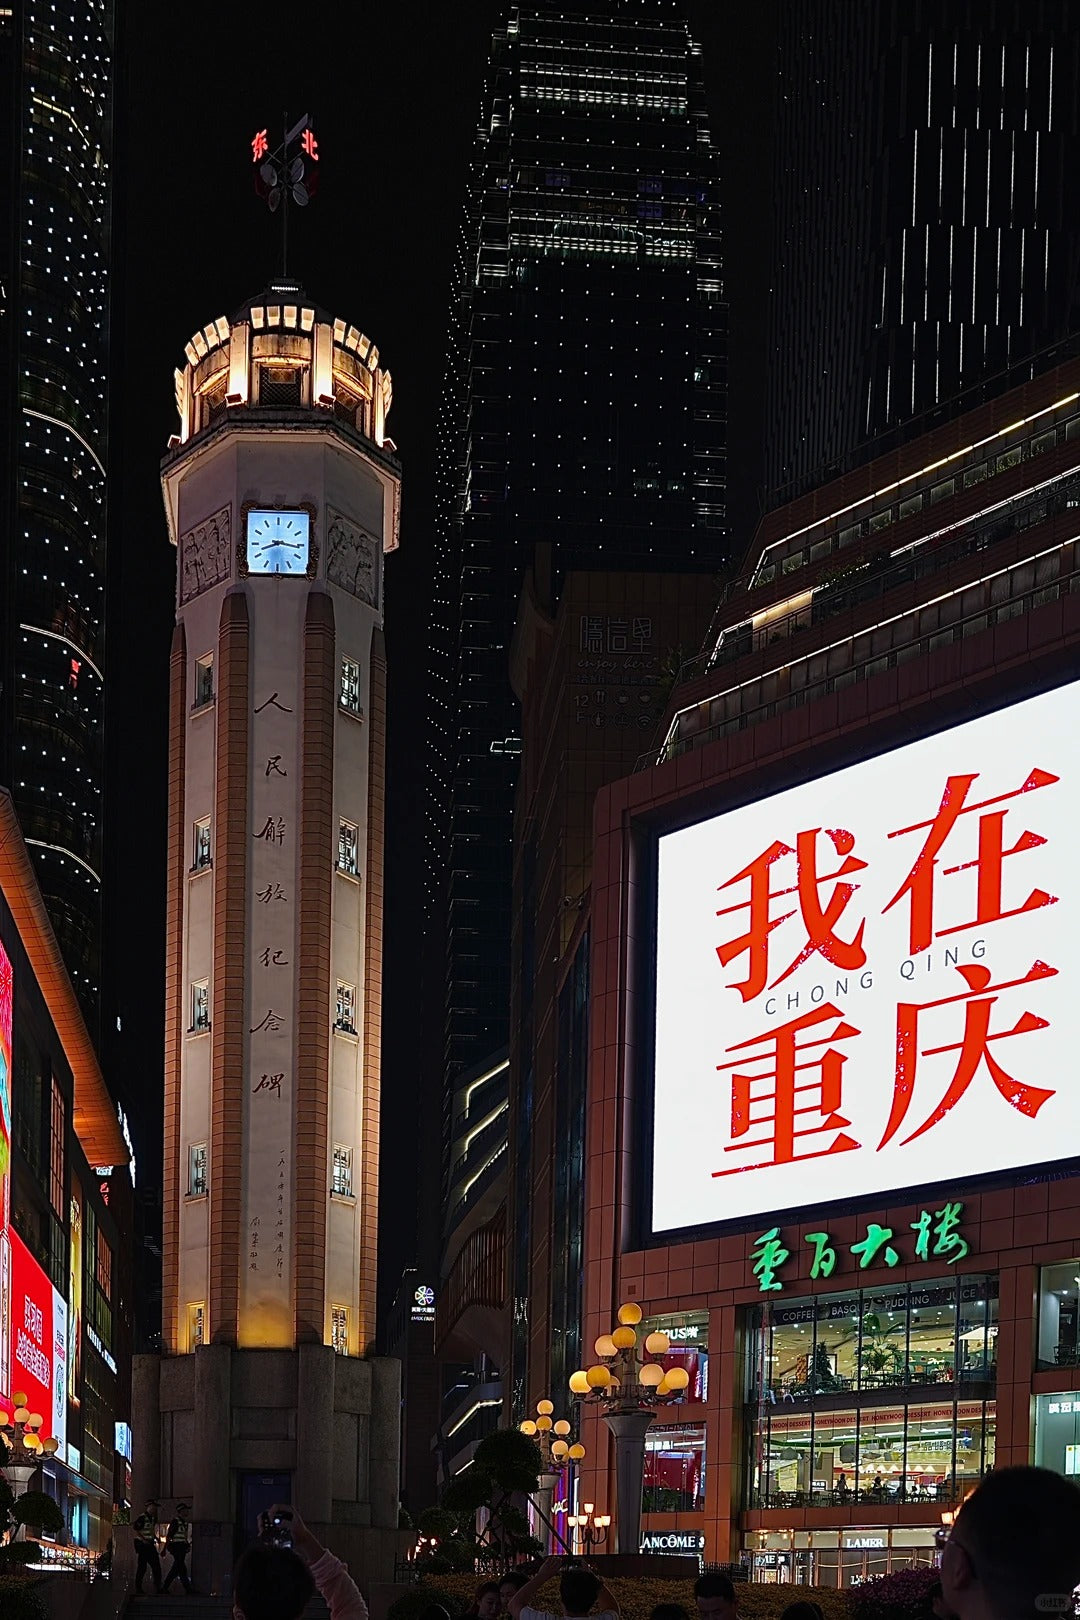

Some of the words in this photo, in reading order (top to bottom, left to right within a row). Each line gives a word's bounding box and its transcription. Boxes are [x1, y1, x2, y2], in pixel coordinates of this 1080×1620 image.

[251, 128, 269, 162] 东
[301, 128, 319, 161] 北
[577, 658, 617, 673] enjoy
[623, 655, 654, 671] here
[715, 767, 1061, 1003] 我在
[764, 970, 875, 1016] CHONG
[899, 939, 987, 981] QING
[711, 959, 1060, 1178] 重庆
[749, 1202, 971, 1292] 重百大楼
